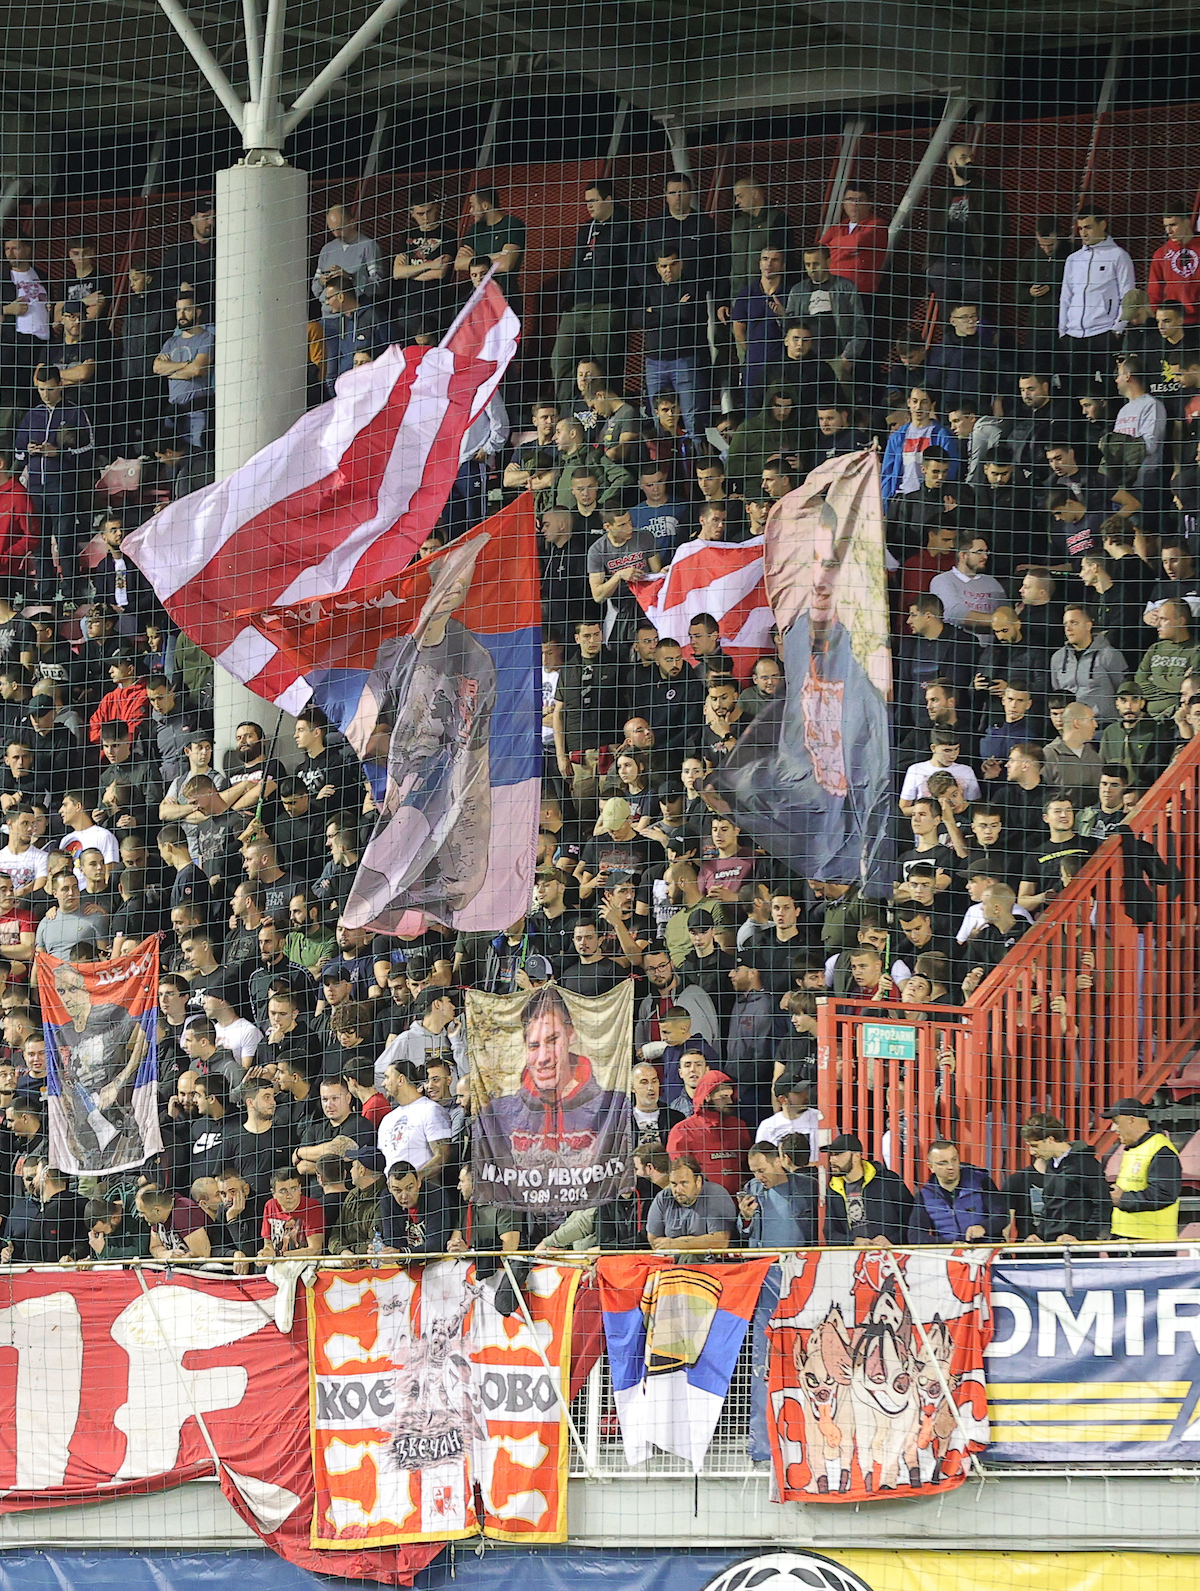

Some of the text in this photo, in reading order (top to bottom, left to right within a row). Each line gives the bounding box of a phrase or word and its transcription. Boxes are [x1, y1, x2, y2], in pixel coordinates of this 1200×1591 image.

[649, 516, 666, 525] THE
[642, 523, 666, 532] ORTH
[607, 552, 643, 569] CRAZY
[888, 1044, 906, 1056] PUT
[482, 1162, 543, 1188] МАРКО
